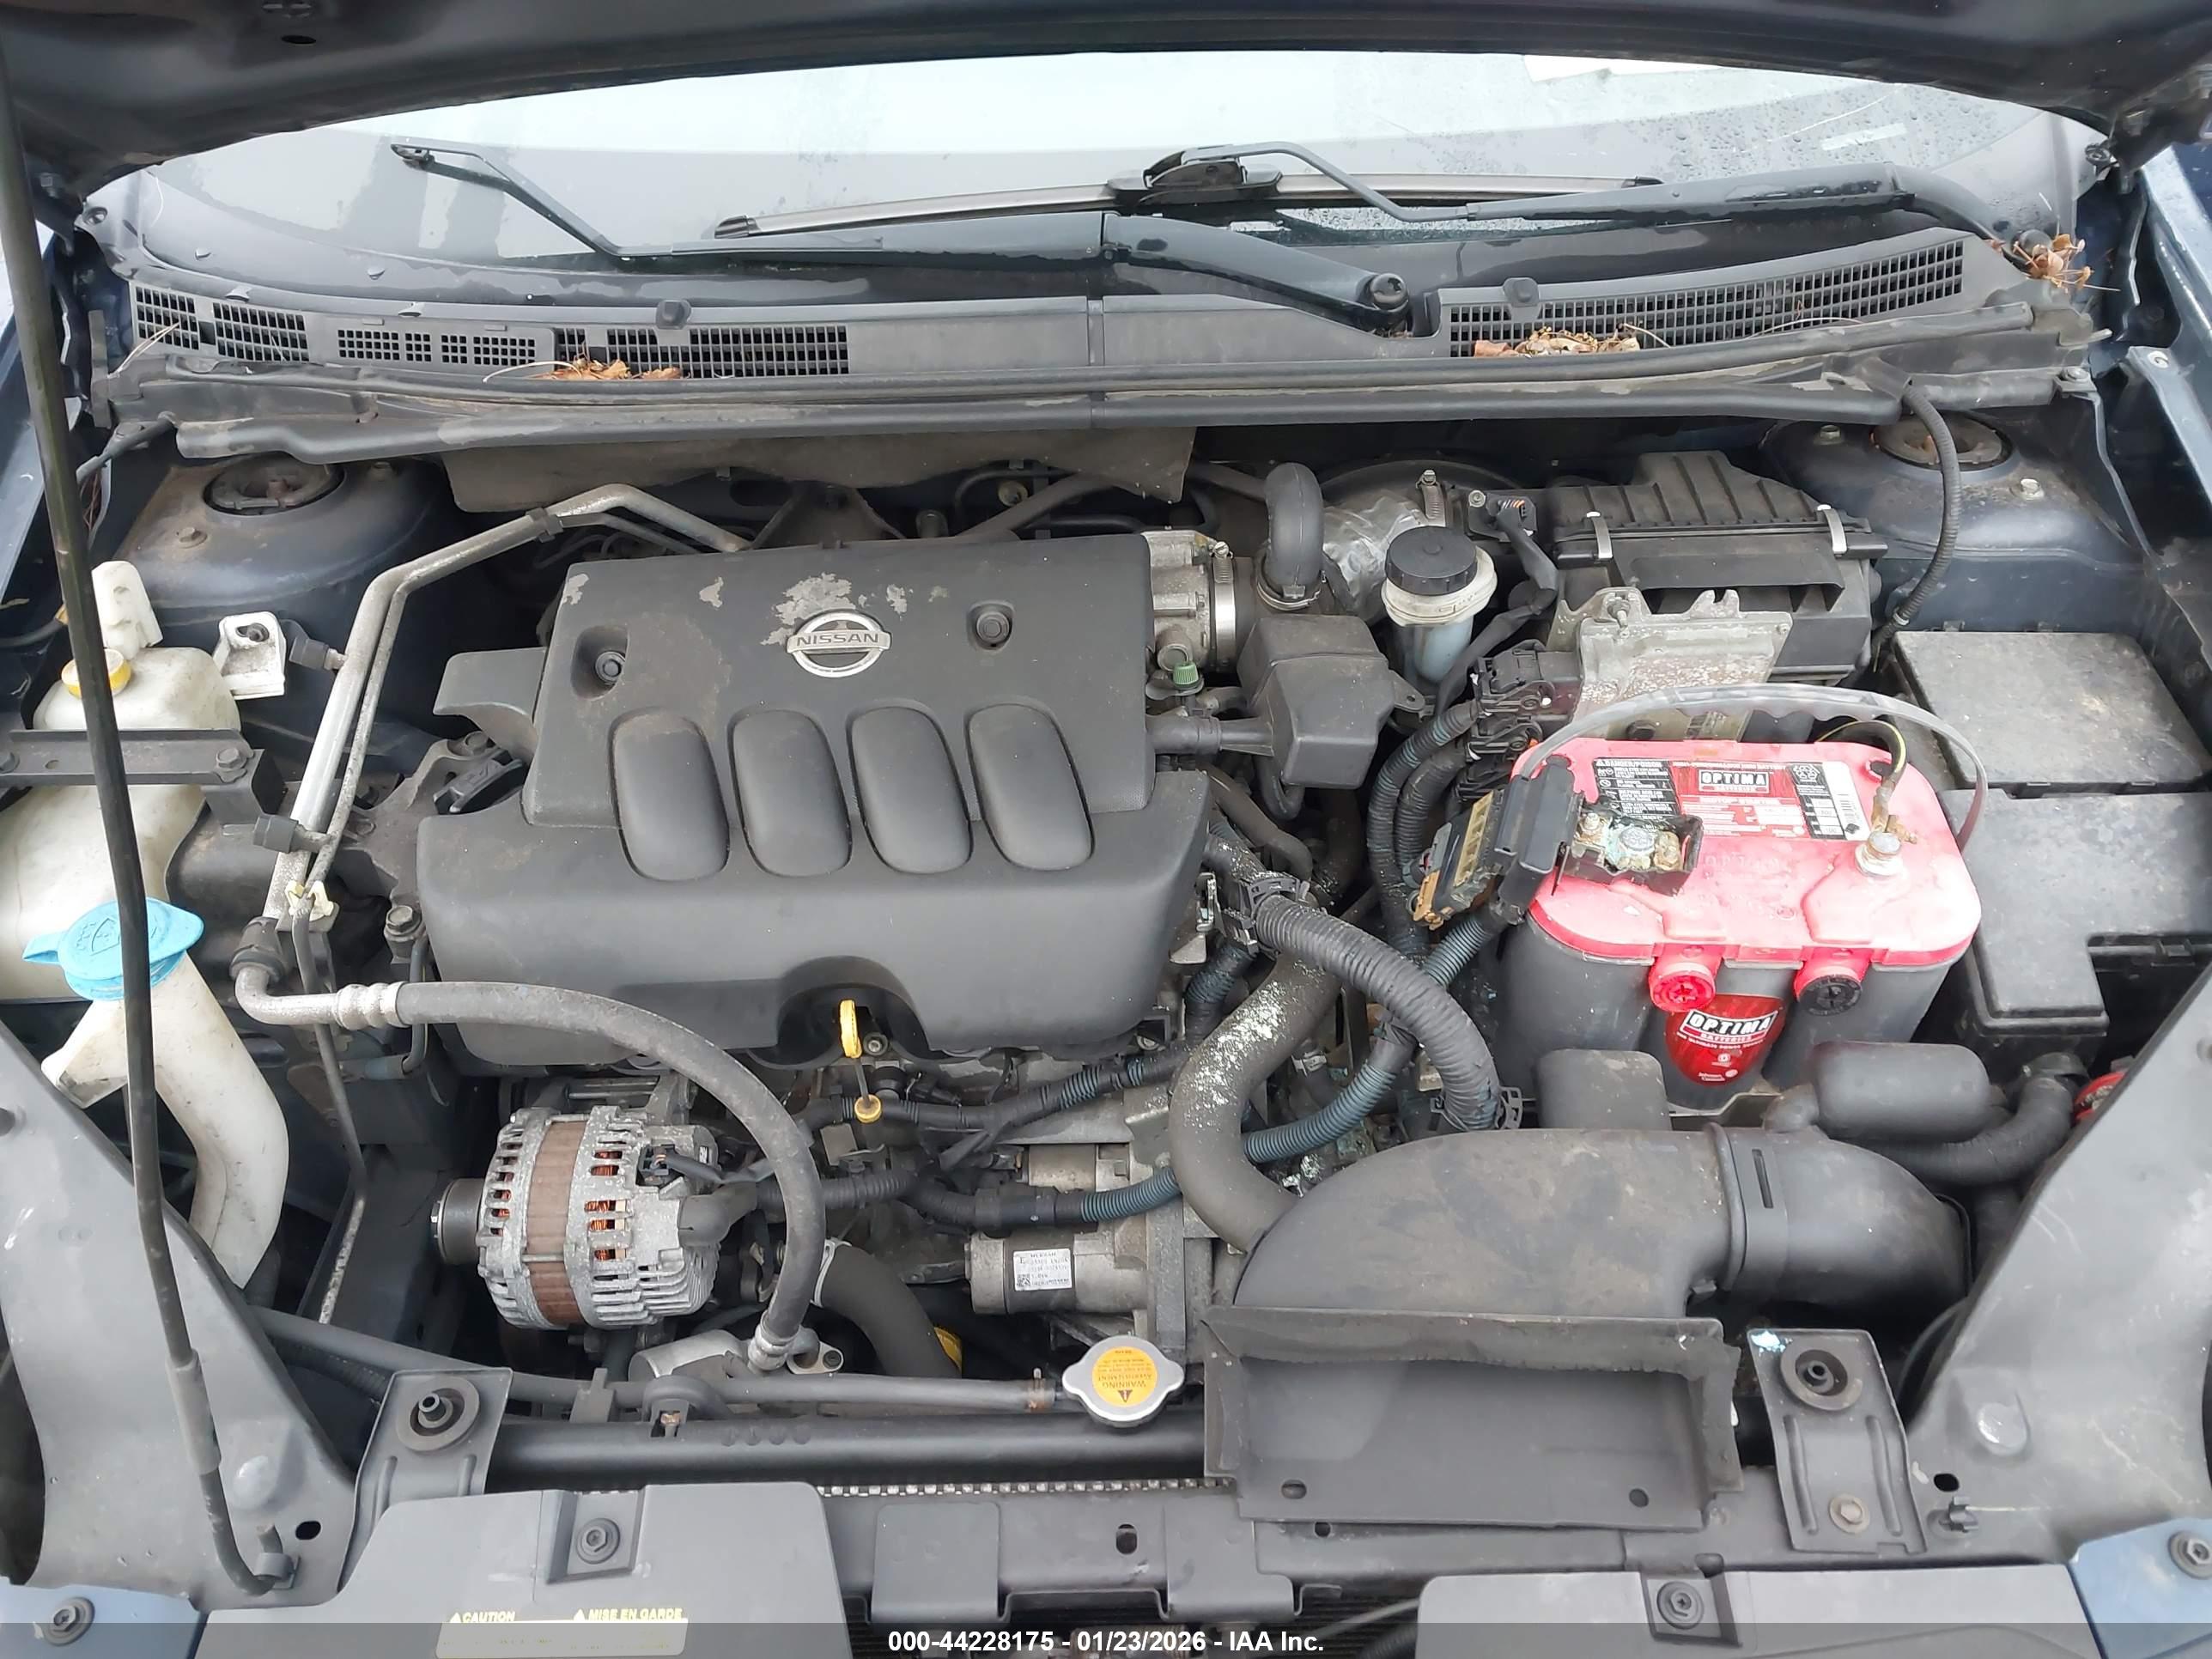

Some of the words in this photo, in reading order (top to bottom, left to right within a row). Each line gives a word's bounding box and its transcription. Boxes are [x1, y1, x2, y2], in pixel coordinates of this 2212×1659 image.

[797, 633, 878, 647] NISSAN
[1701, 771, 1766, 785] OPTIMA
[1689, 1012, 1771, 1035] OPTIMA
[1102, 1380, 1146, 1389] WARNING
[463, 1611, 515, 1623] CAUTION
[588, 1608, 618, 1621] MISE
[620, 1607, 638, 1621] EN
[639, 1607, 683, 1621] GARDE
